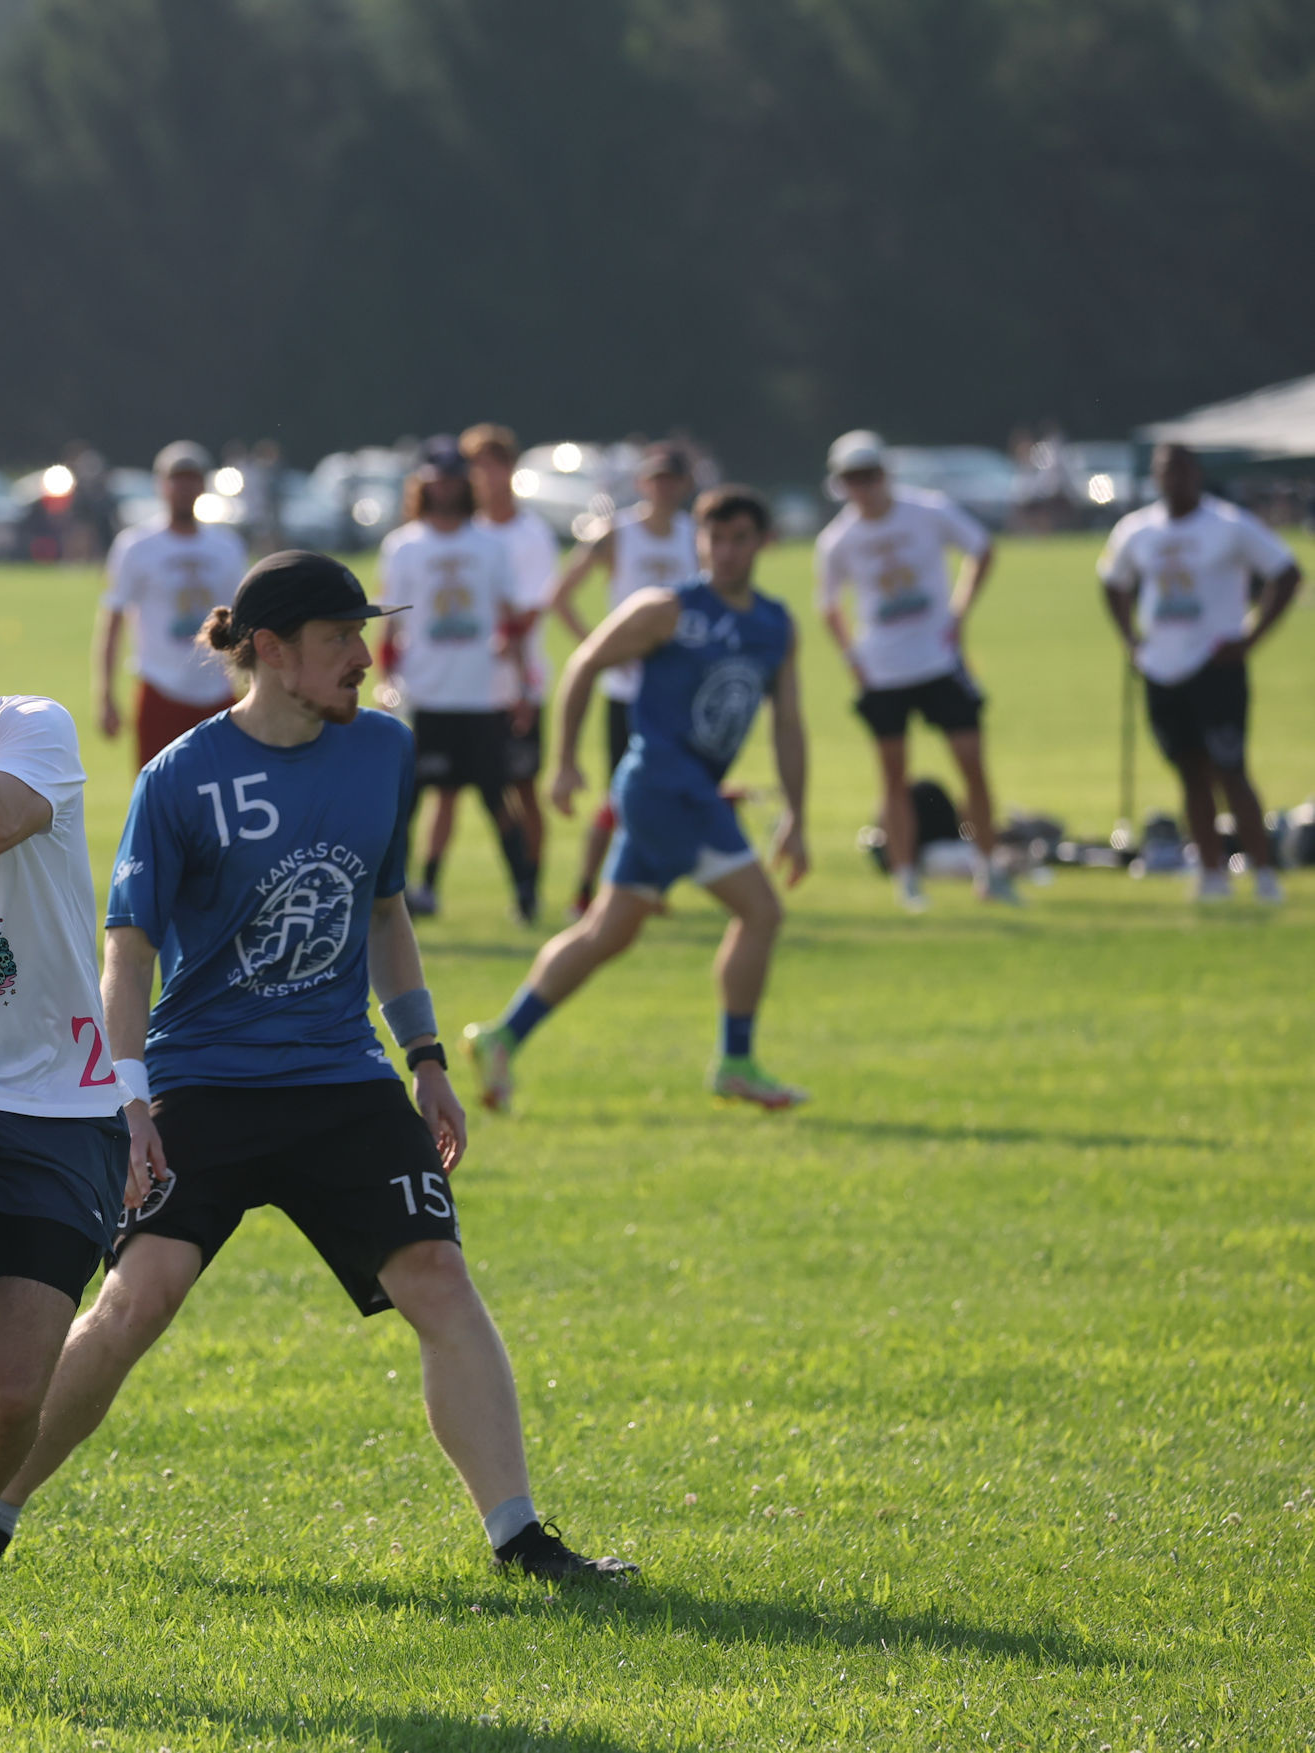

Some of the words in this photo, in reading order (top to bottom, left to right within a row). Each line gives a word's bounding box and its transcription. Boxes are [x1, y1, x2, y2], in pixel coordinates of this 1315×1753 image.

[197, 771, 280, 848] 15
[331, 845, 368, 879] CITY
[227, 967, 339, 998] SOKESTACK
[71, 1016, 117, 1088] 2
[389, 1171, 452, 1217] 15
